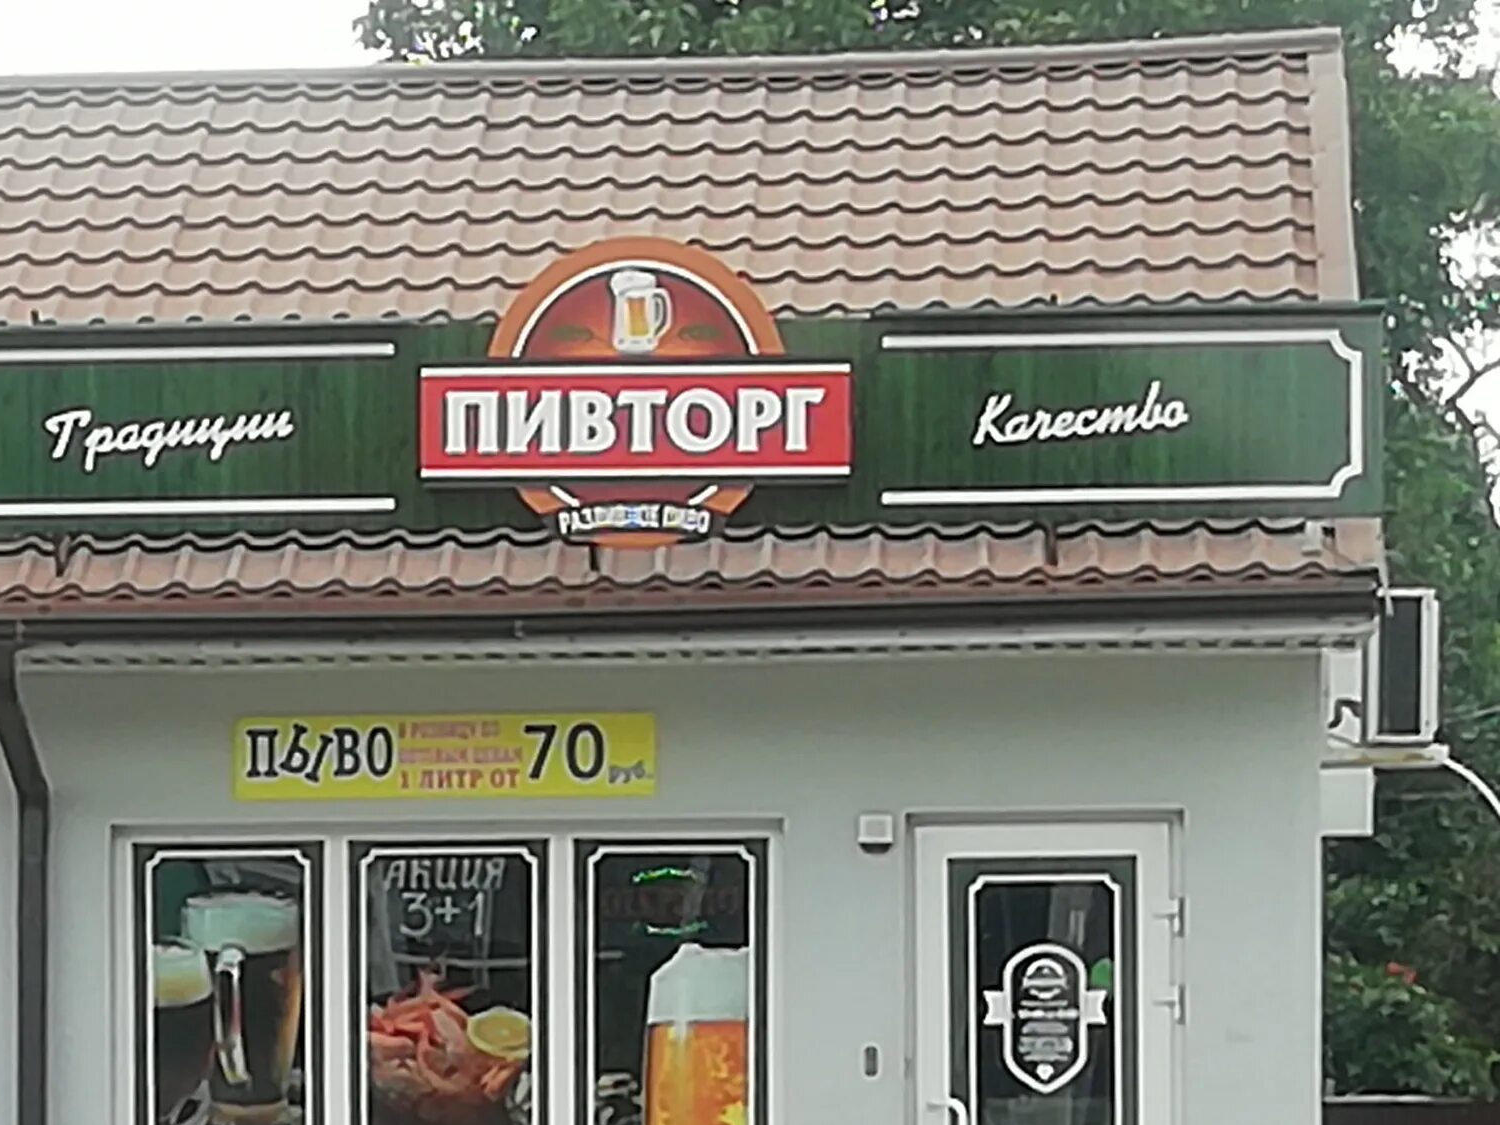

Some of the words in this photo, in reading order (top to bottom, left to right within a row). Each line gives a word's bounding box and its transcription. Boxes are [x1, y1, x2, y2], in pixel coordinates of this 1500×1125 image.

[44, 408, 295, 471] Традиции
[445, 387, 826, 454] ПИВТОРГ
[973, 380, 1190, 445] Качество
[246, 723, 393, 783] ПЫВО
[419, 768, 484, 789] ЛИТР
[490, 768, 520, 789] ОТ
[524, 723, 605, 780] 70
[384, 857, 506, 893] АКЦИЯ
[399, 890, 485, 938] 3+1
